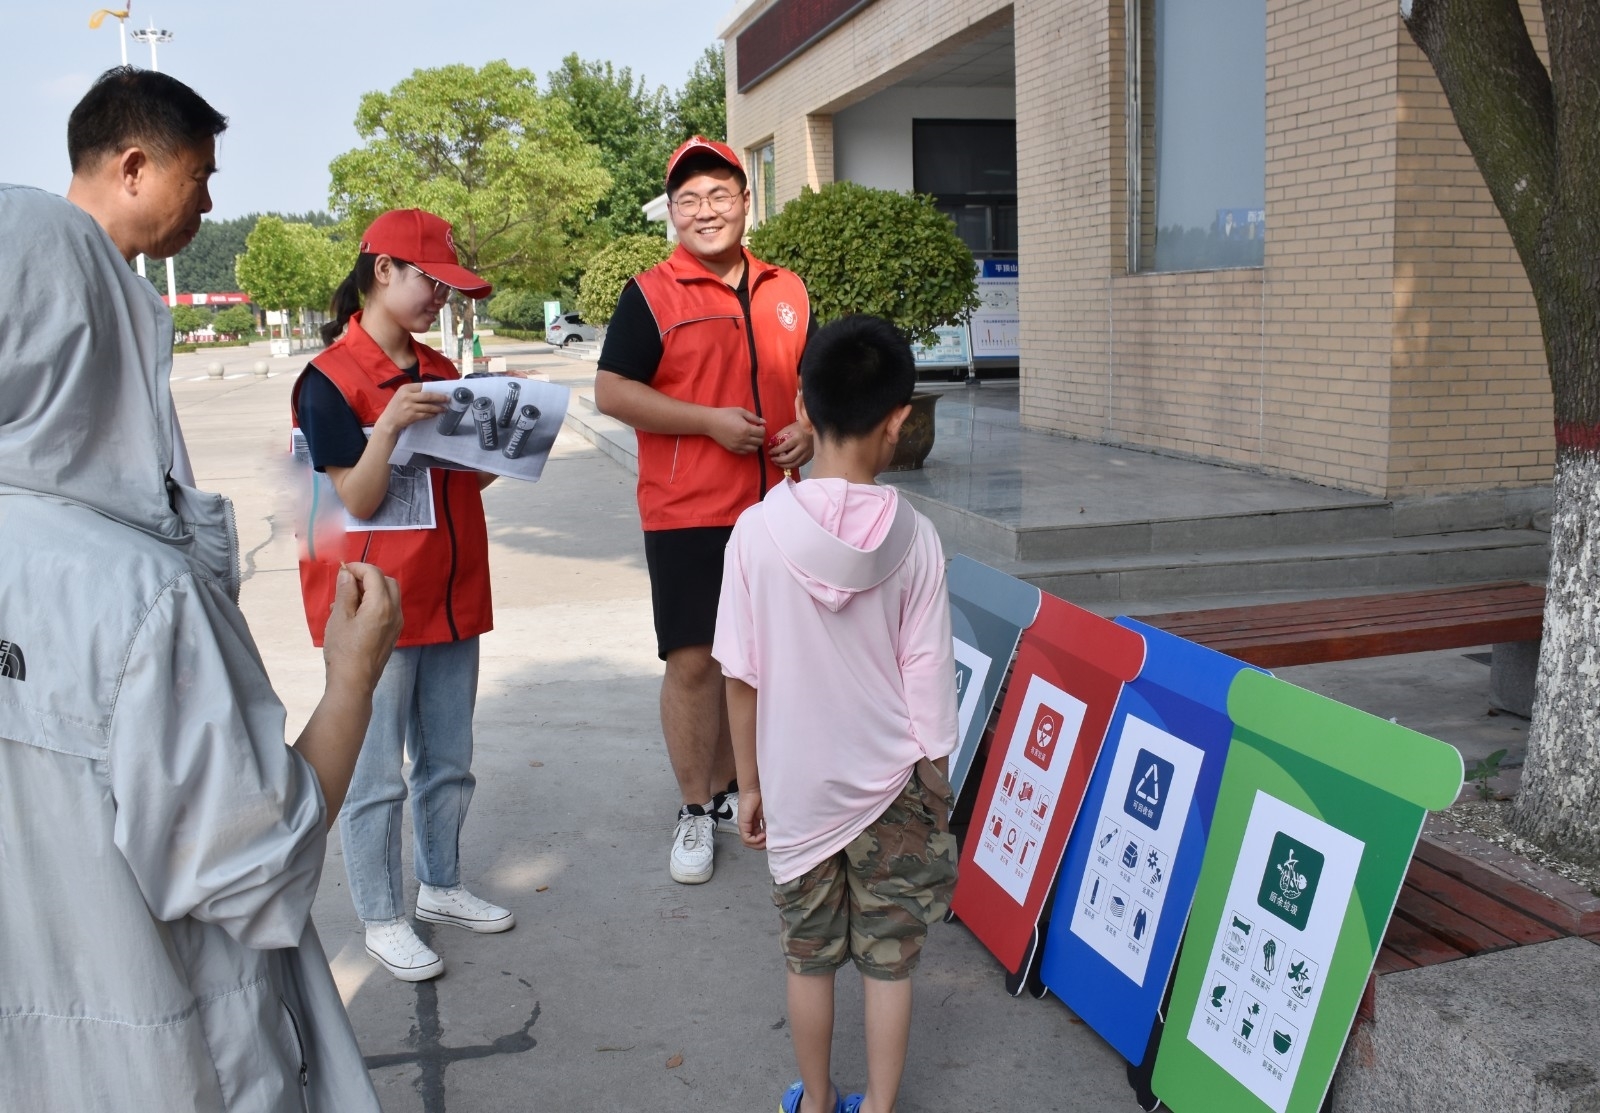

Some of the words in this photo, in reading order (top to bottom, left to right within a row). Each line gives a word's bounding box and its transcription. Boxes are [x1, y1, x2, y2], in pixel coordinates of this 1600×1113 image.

[482, 420, 494, 447] WALLY
[505, 429, 525, 456] WALLY
[1132, 800, 1154, 819] 可回收物
[1268, 891, 1298, 916] 厨余垃圾
